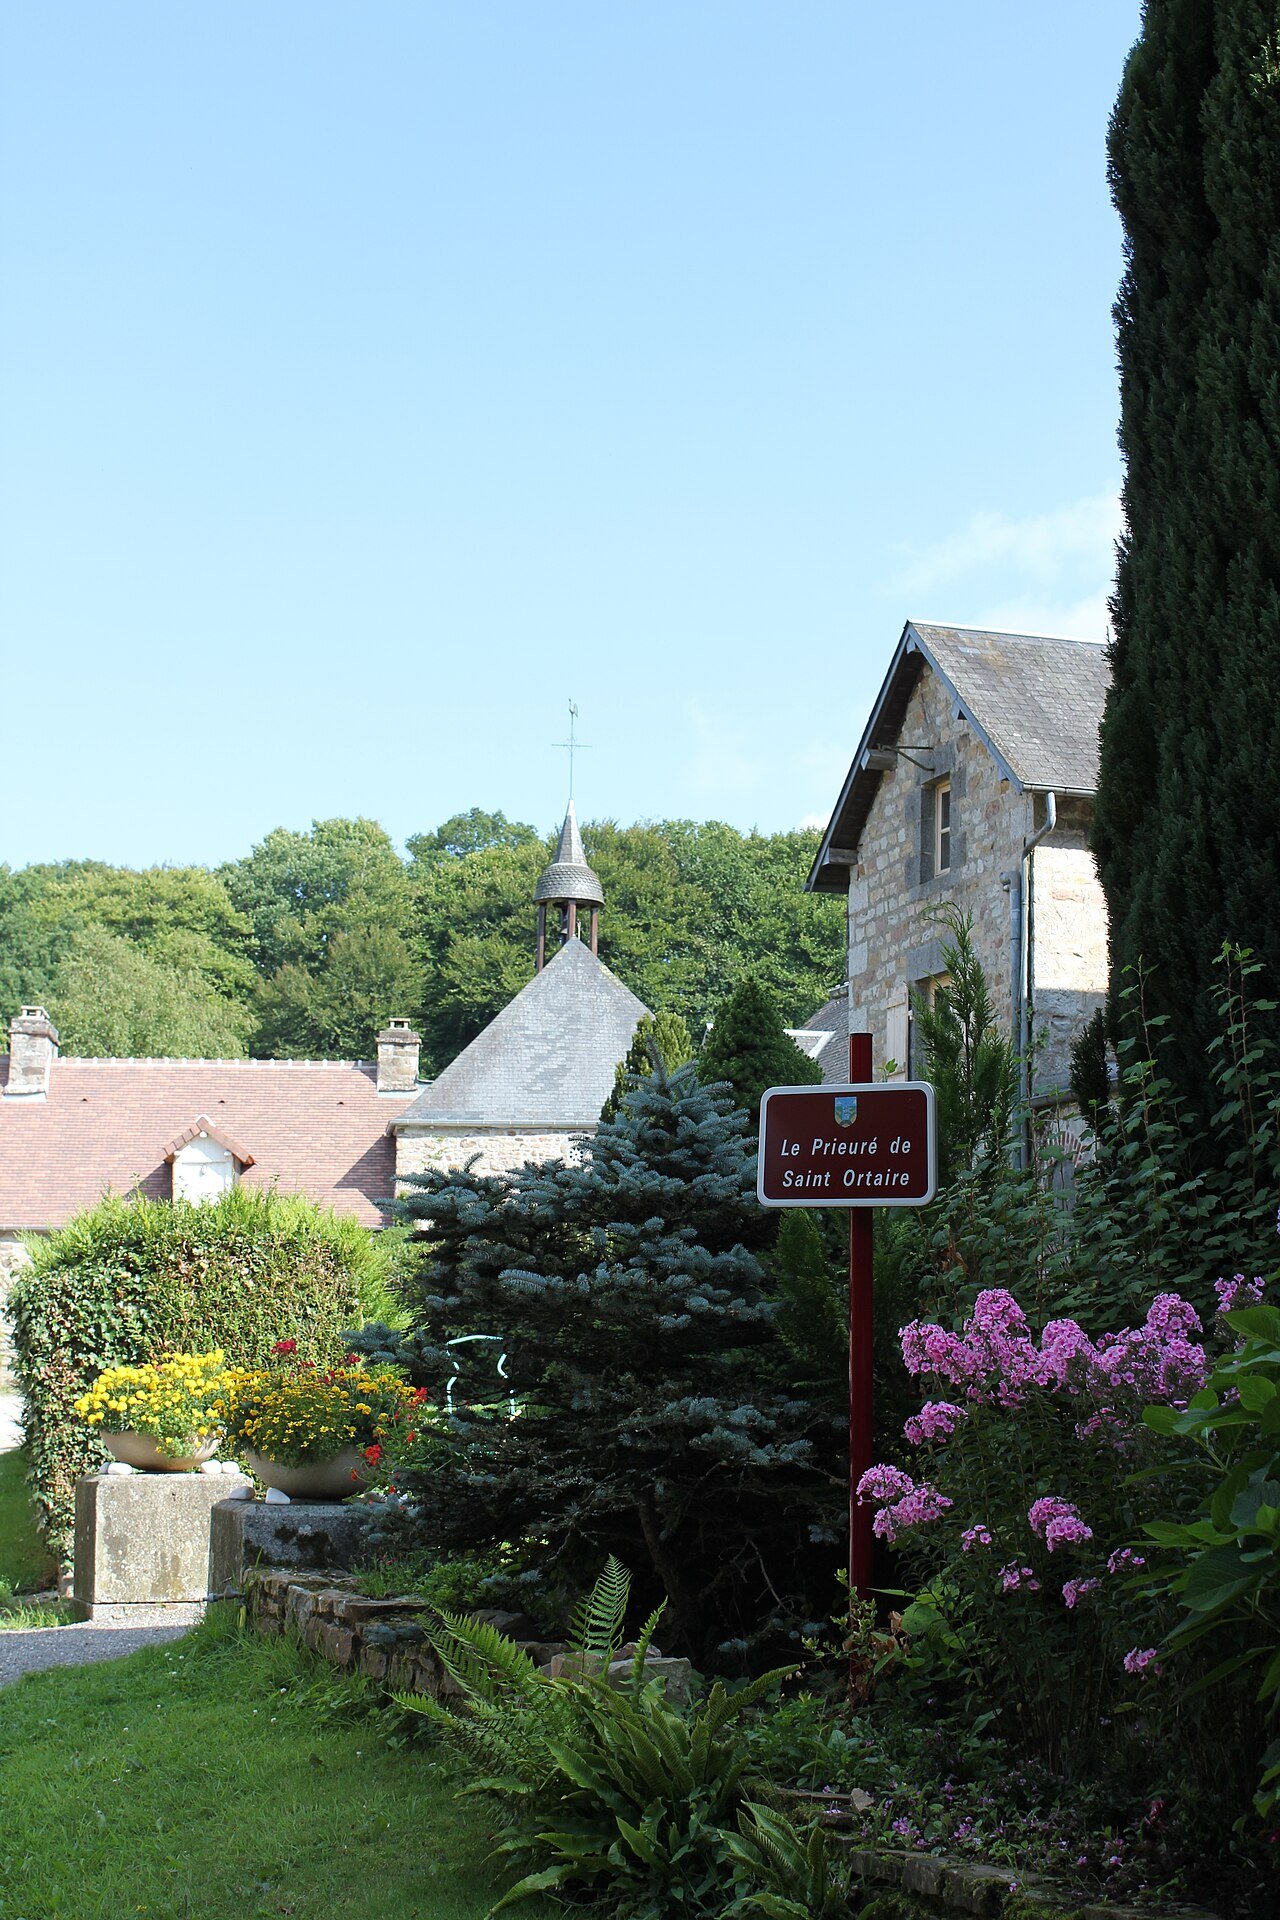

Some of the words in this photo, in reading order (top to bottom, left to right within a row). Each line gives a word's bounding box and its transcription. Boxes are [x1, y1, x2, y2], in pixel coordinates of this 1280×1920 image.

[780, 1139, 800, 1156] Le
[811, 1137, 878, 1156] Prieuré
[889, 1136, 911, 1154] de
[782, 1170, 831, 1187] Saint
[843, 1168, 910, 1187] Ortaire
